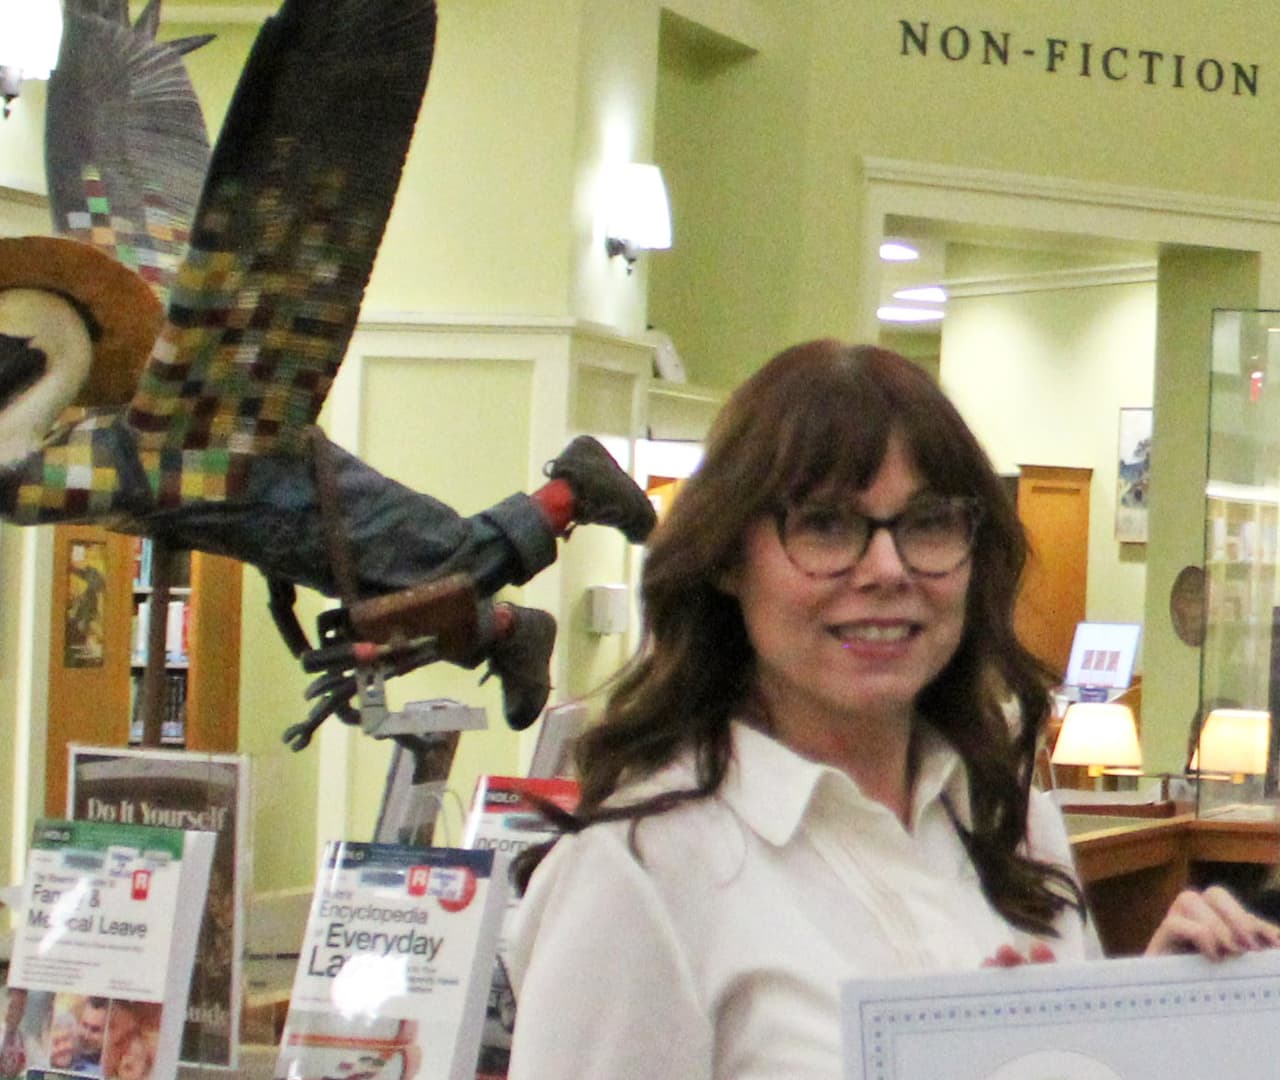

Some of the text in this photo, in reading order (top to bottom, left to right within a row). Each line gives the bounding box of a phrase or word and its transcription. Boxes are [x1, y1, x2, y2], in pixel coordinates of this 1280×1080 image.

[900, 20, 1261, 96] NON-FICTION
[87, 797, 228, 831] Do It Yourself
[99, 916, 148, 938] Leave
[320, 901, 428, 925] Encyclopedia
[325, 923, 444, 961] Everyday
[307, 945, 352, 977] La
